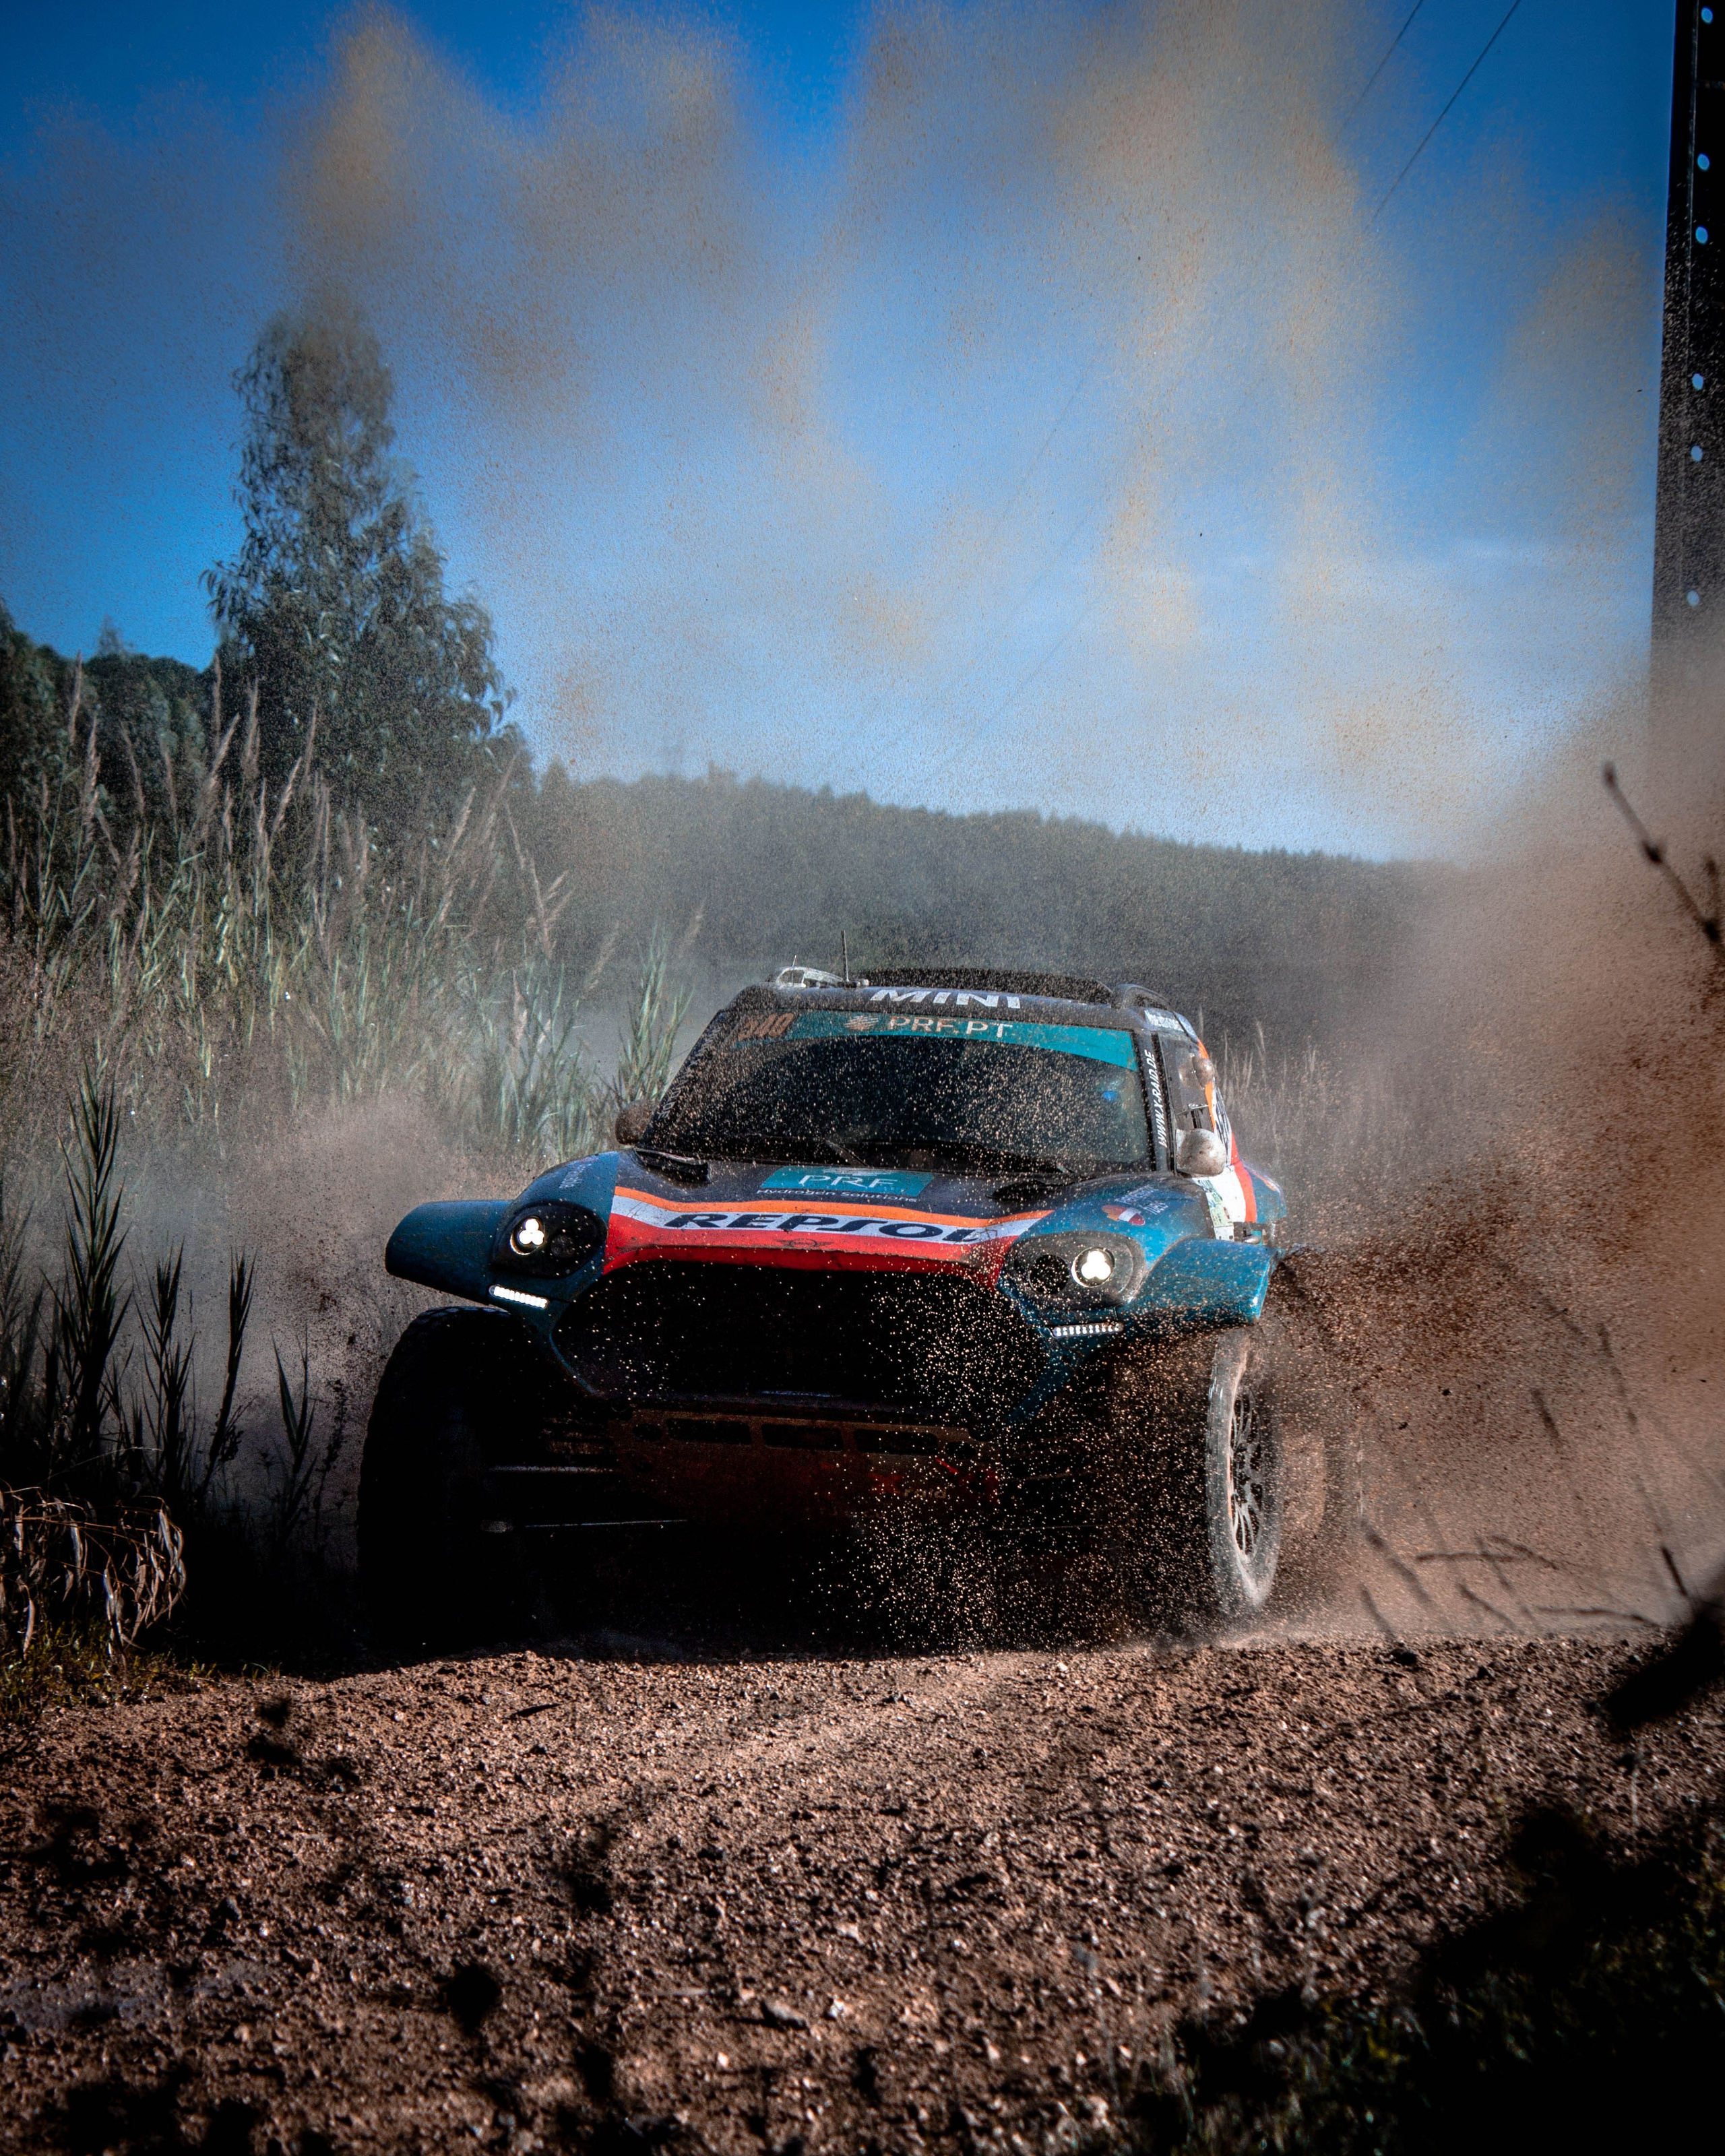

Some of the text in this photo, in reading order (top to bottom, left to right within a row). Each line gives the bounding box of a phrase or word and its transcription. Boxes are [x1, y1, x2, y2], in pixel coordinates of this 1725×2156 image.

[870, 989, 1020, 1009] MINI
[1144, 1049, 1167, 1148] WWW.X-RAID.DE
[798, 1174, 898, 1188] PRF
[756, 1188, 918, 1203] Hydrogen Solutions
[664, 1213, 980, 1242] REPSOL
